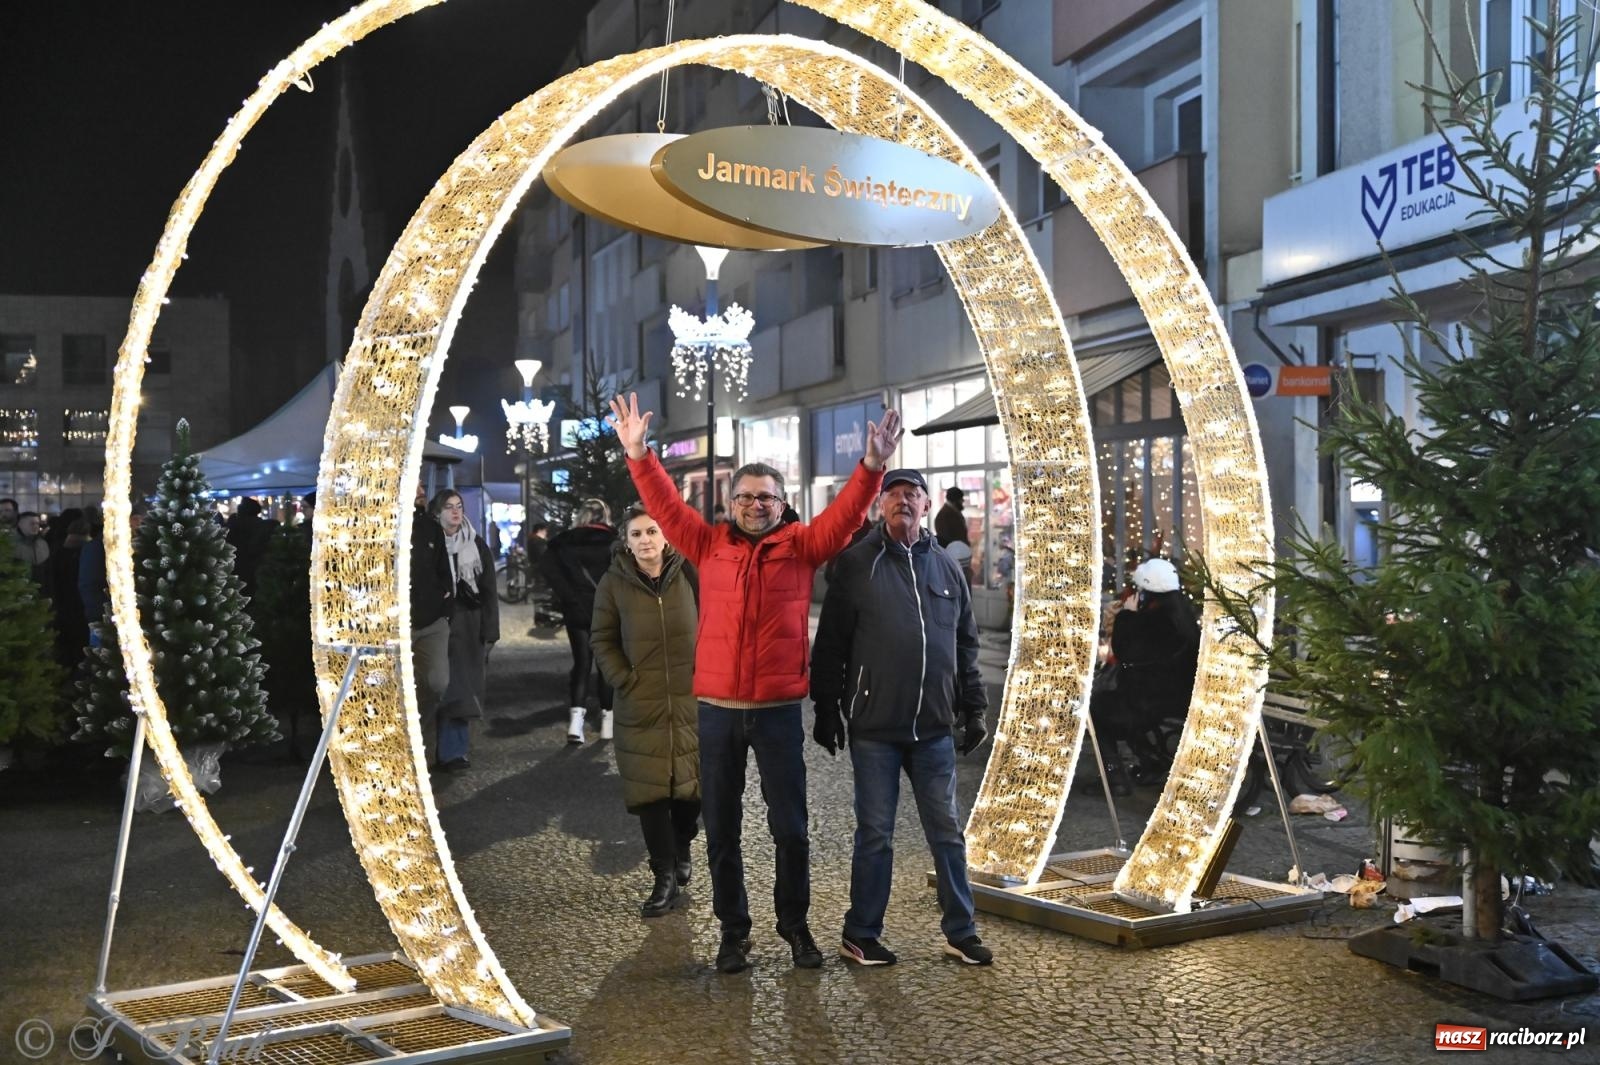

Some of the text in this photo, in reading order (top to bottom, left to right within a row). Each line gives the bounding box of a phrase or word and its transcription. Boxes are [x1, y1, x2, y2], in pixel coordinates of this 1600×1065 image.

[698, 153, 973, 221] Jarmark Świąteczny
[1402, 143, 1456, 195] TEB
[1401, 191, 1456, 221] EDUKACJA
[1282, 375, 1331, 387] bankomat
